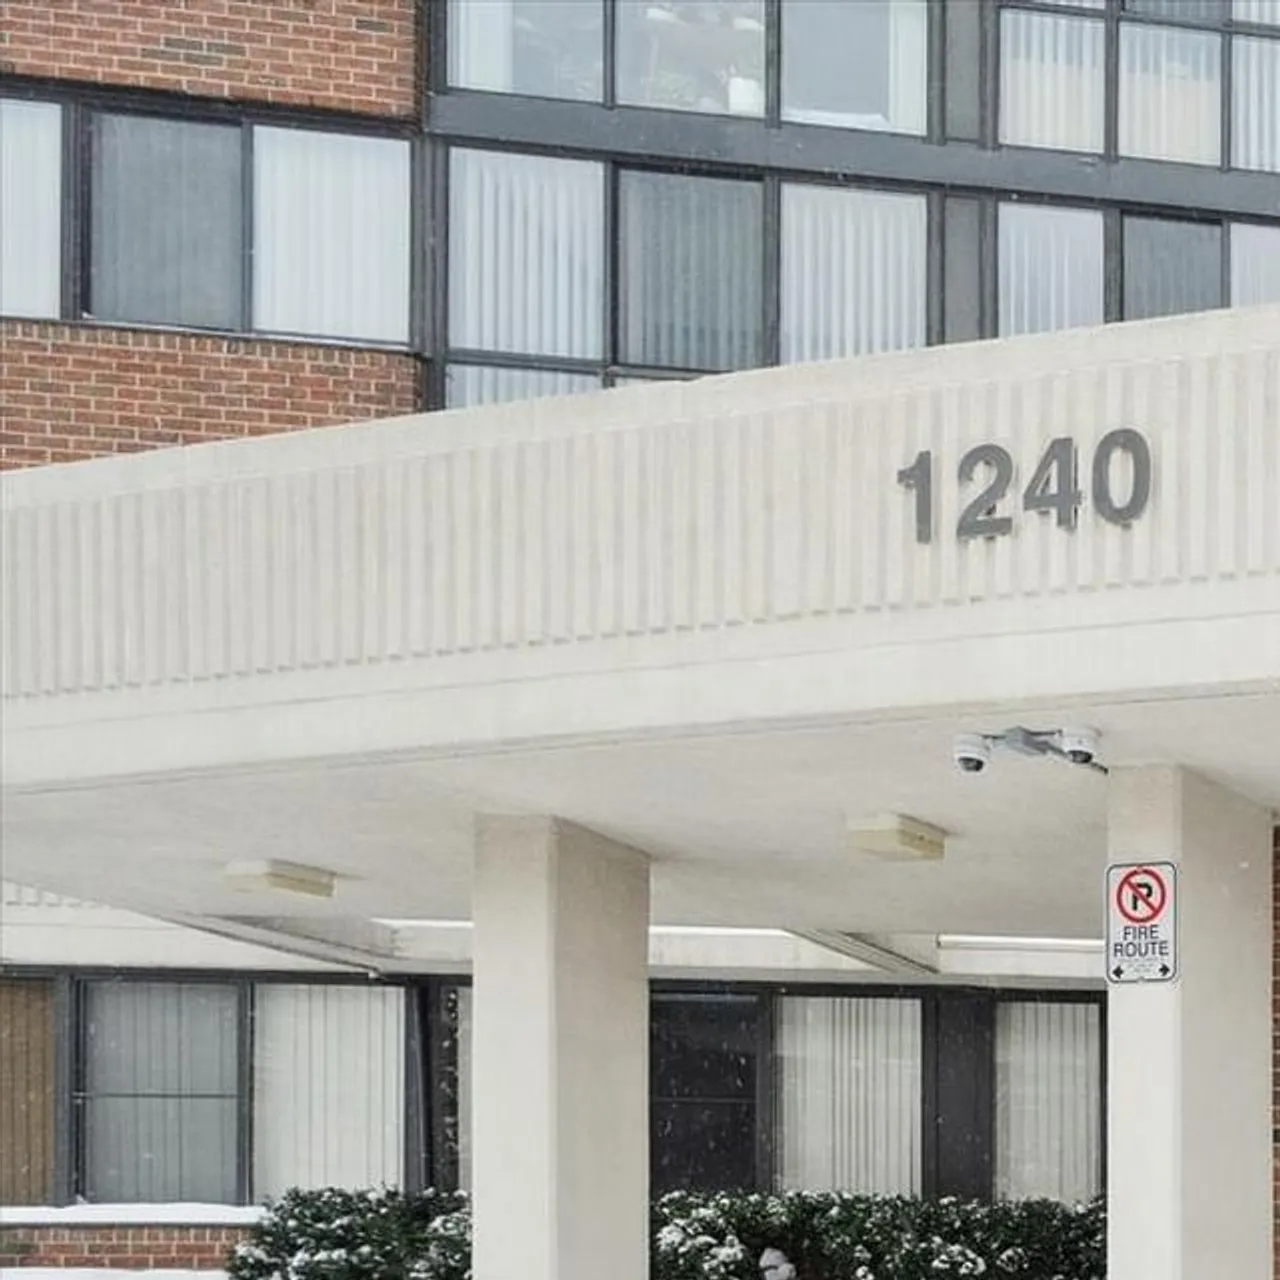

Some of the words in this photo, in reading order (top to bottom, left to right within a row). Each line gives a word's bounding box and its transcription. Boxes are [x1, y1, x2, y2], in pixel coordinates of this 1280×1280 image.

[897, 428, 1152, 544] 1240
[1123, 924, 1159, 941] FIRE
[1113, 941, 1169, 958] ROUTE
